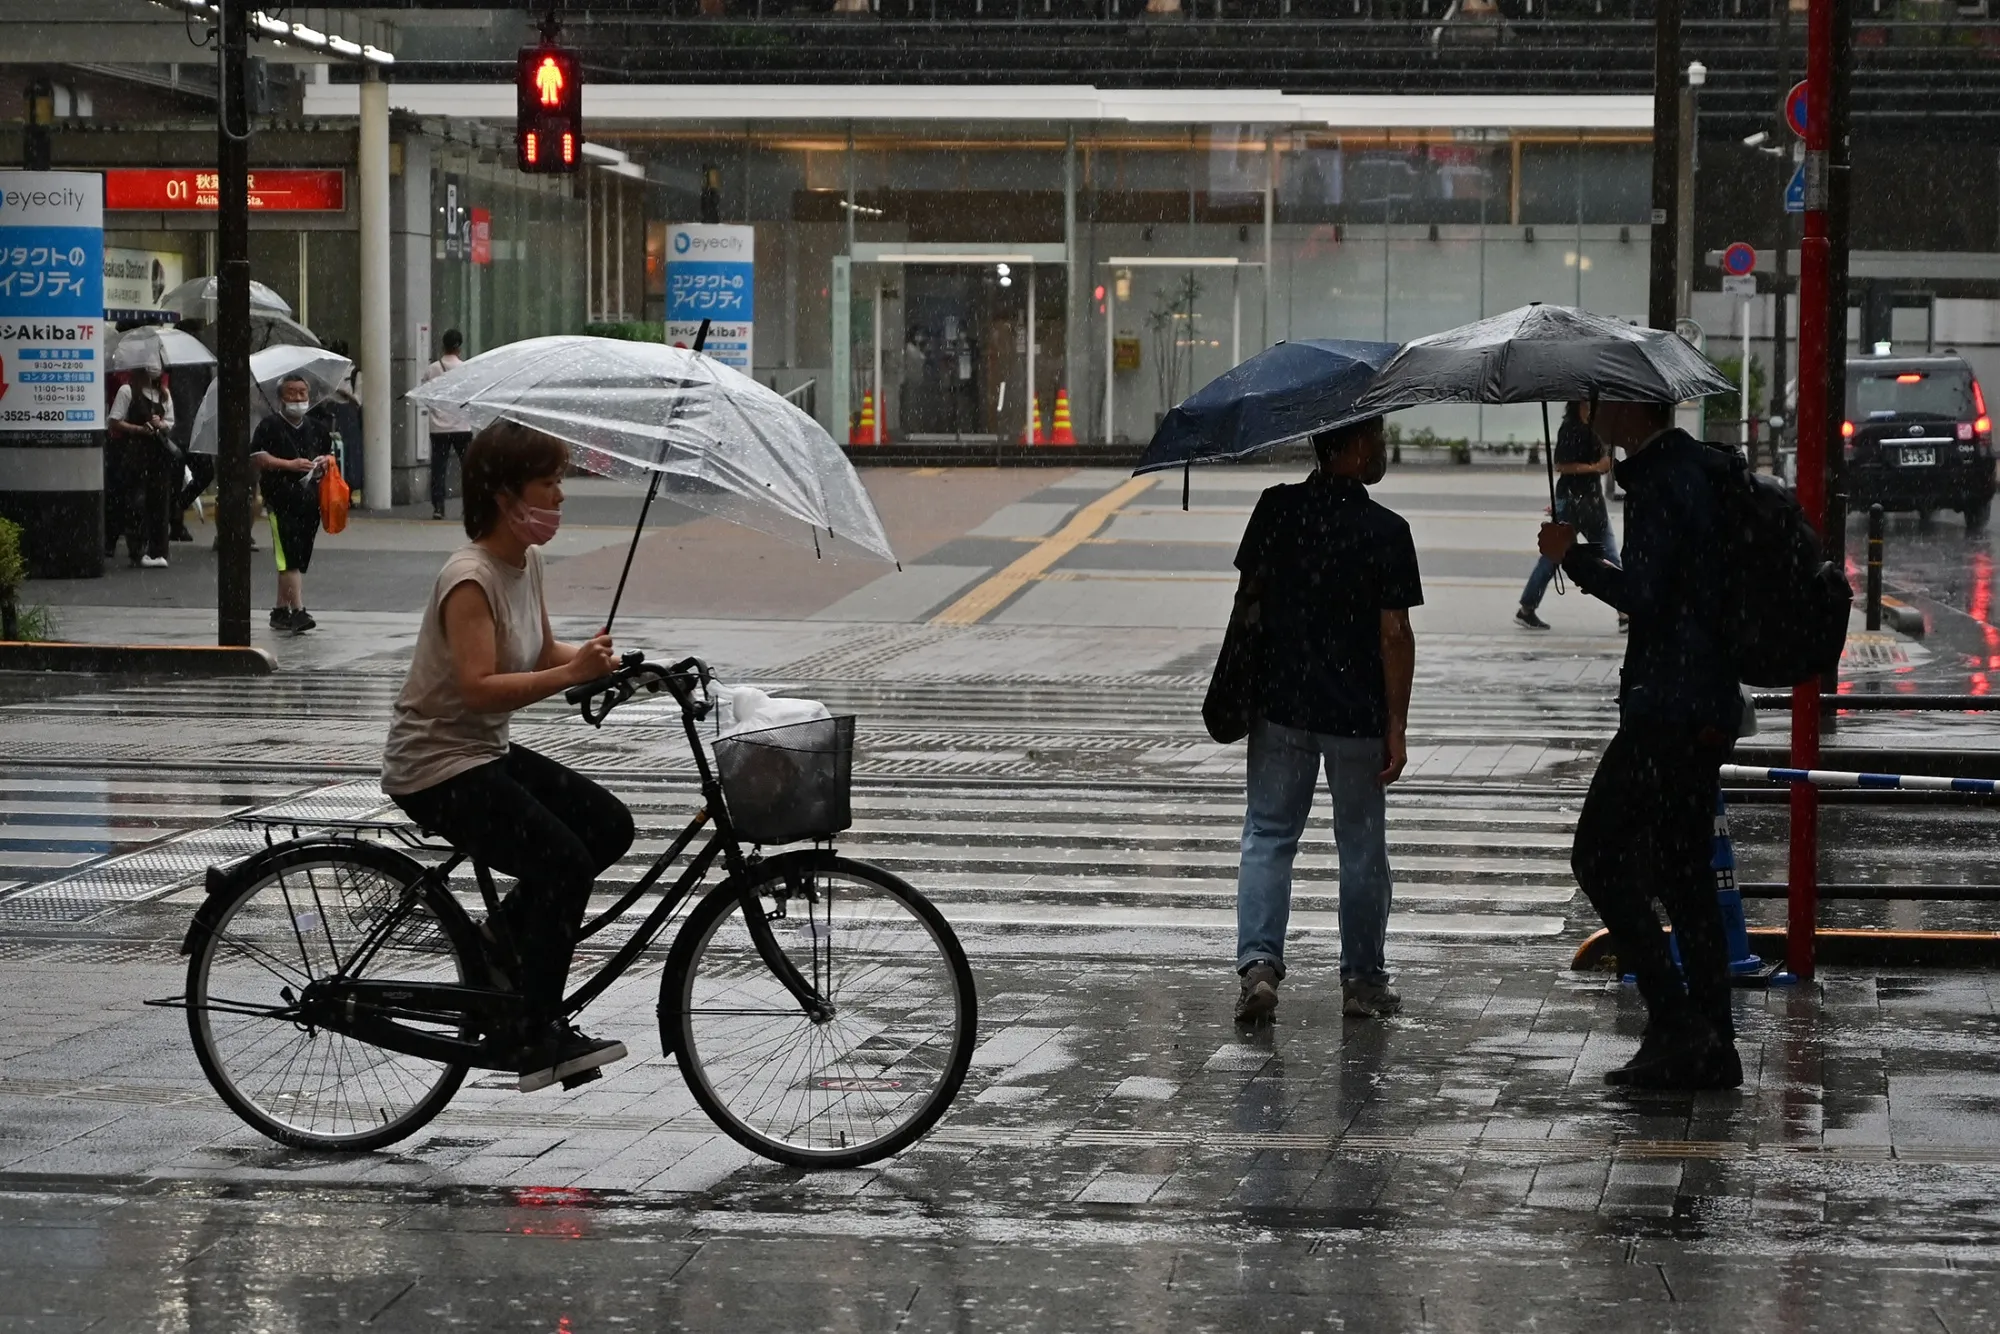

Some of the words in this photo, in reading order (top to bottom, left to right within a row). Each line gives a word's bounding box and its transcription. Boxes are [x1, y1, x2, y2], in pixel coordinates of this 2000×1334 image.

[166, 180, 187, 199] 01
[6, 188, 84, 212] eyecity
[692, 236, 744, 252] eyecity
[673, 275, 744, 288] コンタクトの
[673, 291, 742, 309] アイシティ
